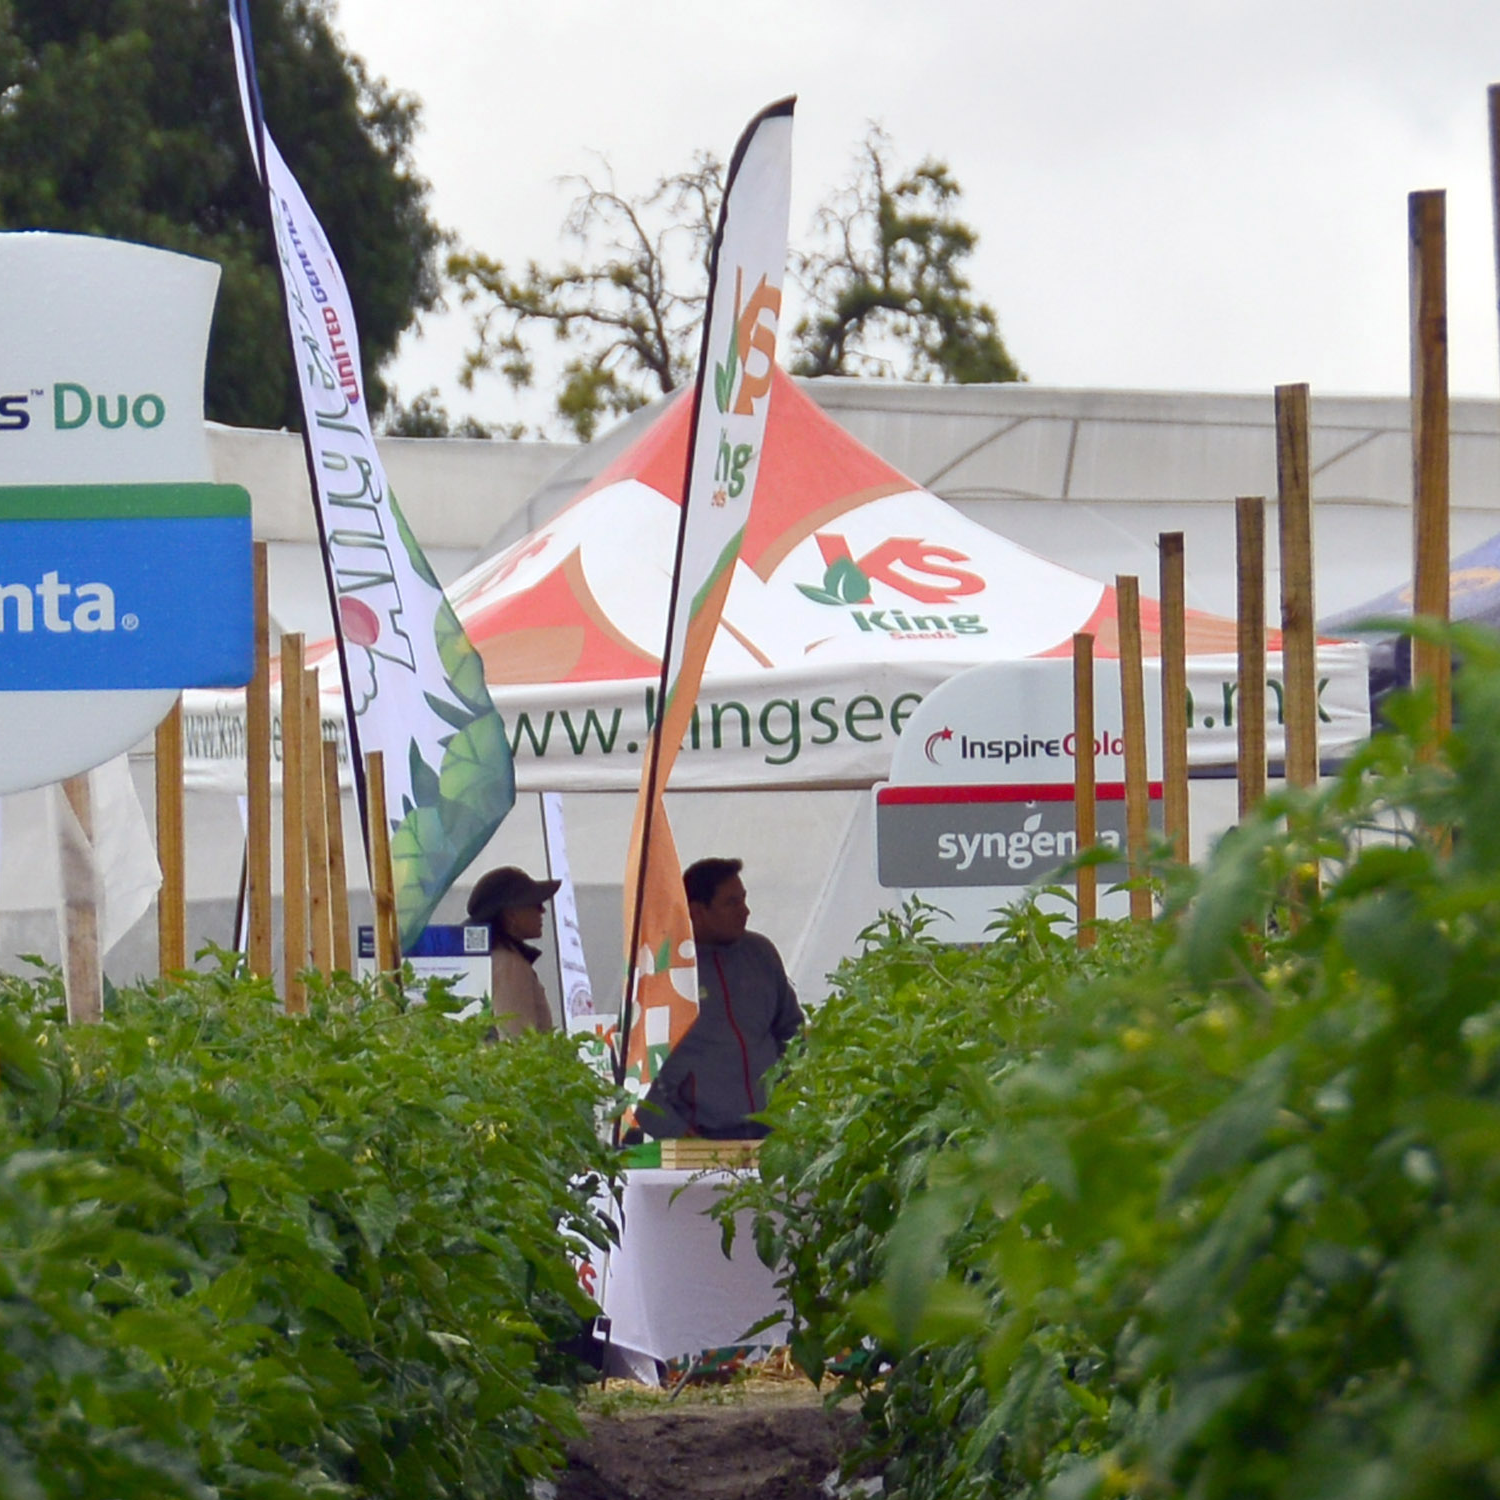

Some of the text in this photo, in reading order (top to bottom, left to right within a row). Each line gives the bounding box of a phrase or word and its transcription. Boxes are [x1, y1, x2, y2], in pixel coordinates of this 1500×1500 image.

[54, 382, 166, 430] Duo
[851, 609, 989, 634] King
[889, 630, 958, 641] Seeds
[938, 828, 1121, 871] syngena
